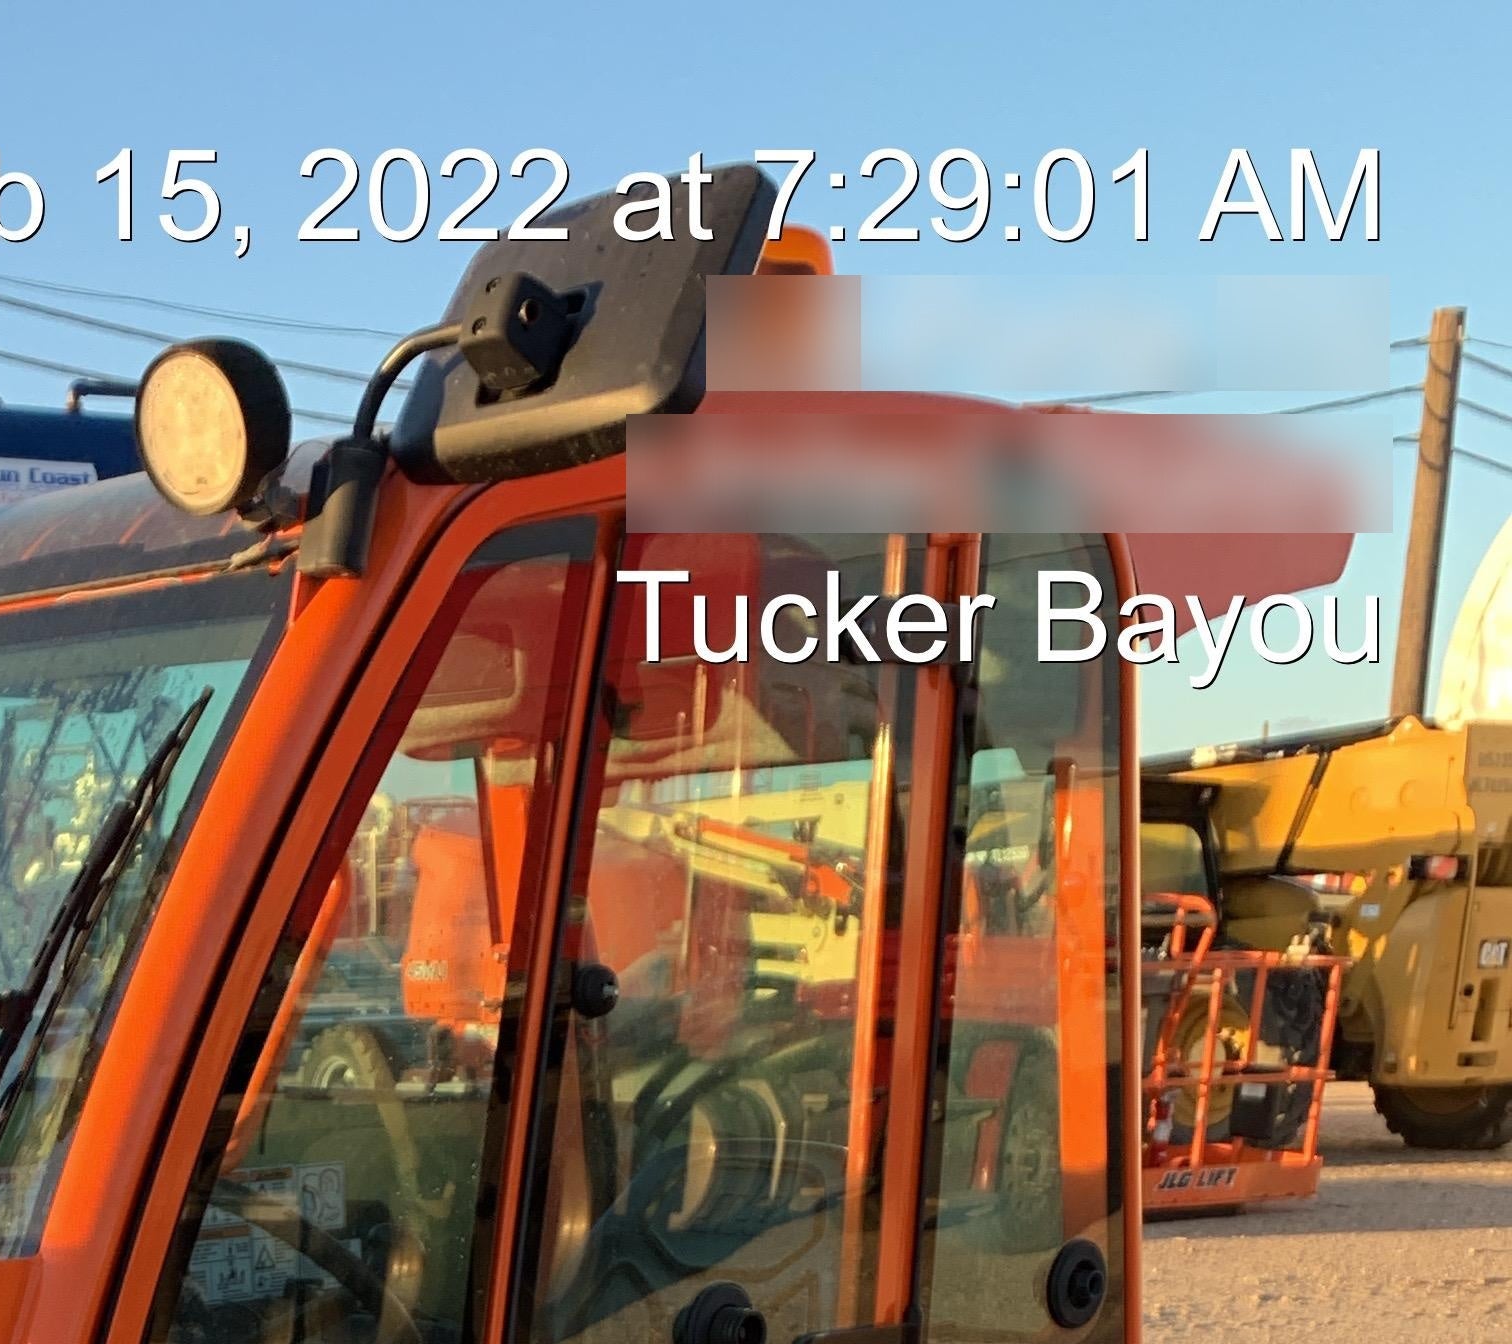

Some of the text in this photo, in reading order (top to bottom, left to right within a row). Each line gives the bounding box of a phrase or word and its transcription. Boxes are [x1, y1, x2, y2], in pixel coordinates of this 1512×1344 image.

[29, 467, 92, 486] Coast
[1479, 941, 1508, 967] CAT
[1196, 1167, 1238, 1187] LIFT
